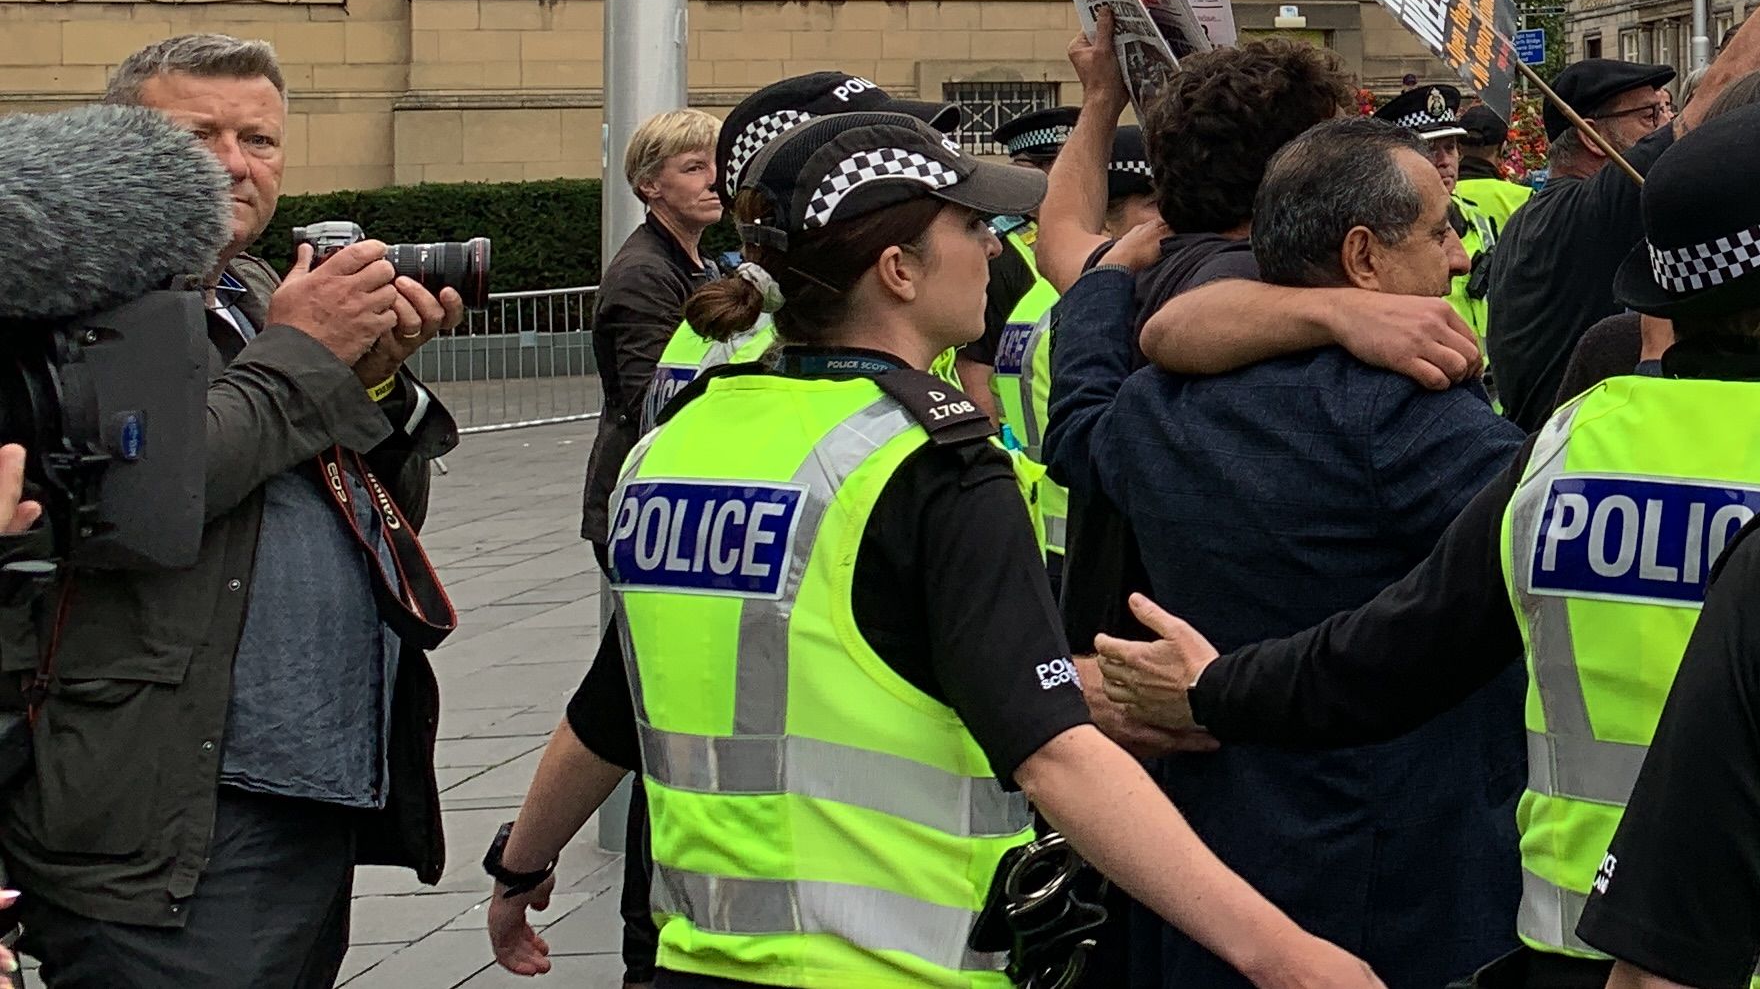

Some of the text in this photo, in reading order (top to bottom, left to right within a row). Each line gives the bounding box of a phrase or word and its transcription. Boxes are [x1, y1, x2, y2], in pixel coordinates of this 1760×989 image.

[1469, 60, 1491, 88] No
[827, 360, 889, 371] POLICE SCOT
[928, 390, 946, 402] D
[928, 400, 976, 421] 1708
[608, 495, 788, 578] POLICE
[1541, 492, 1756, 584] POLIC
